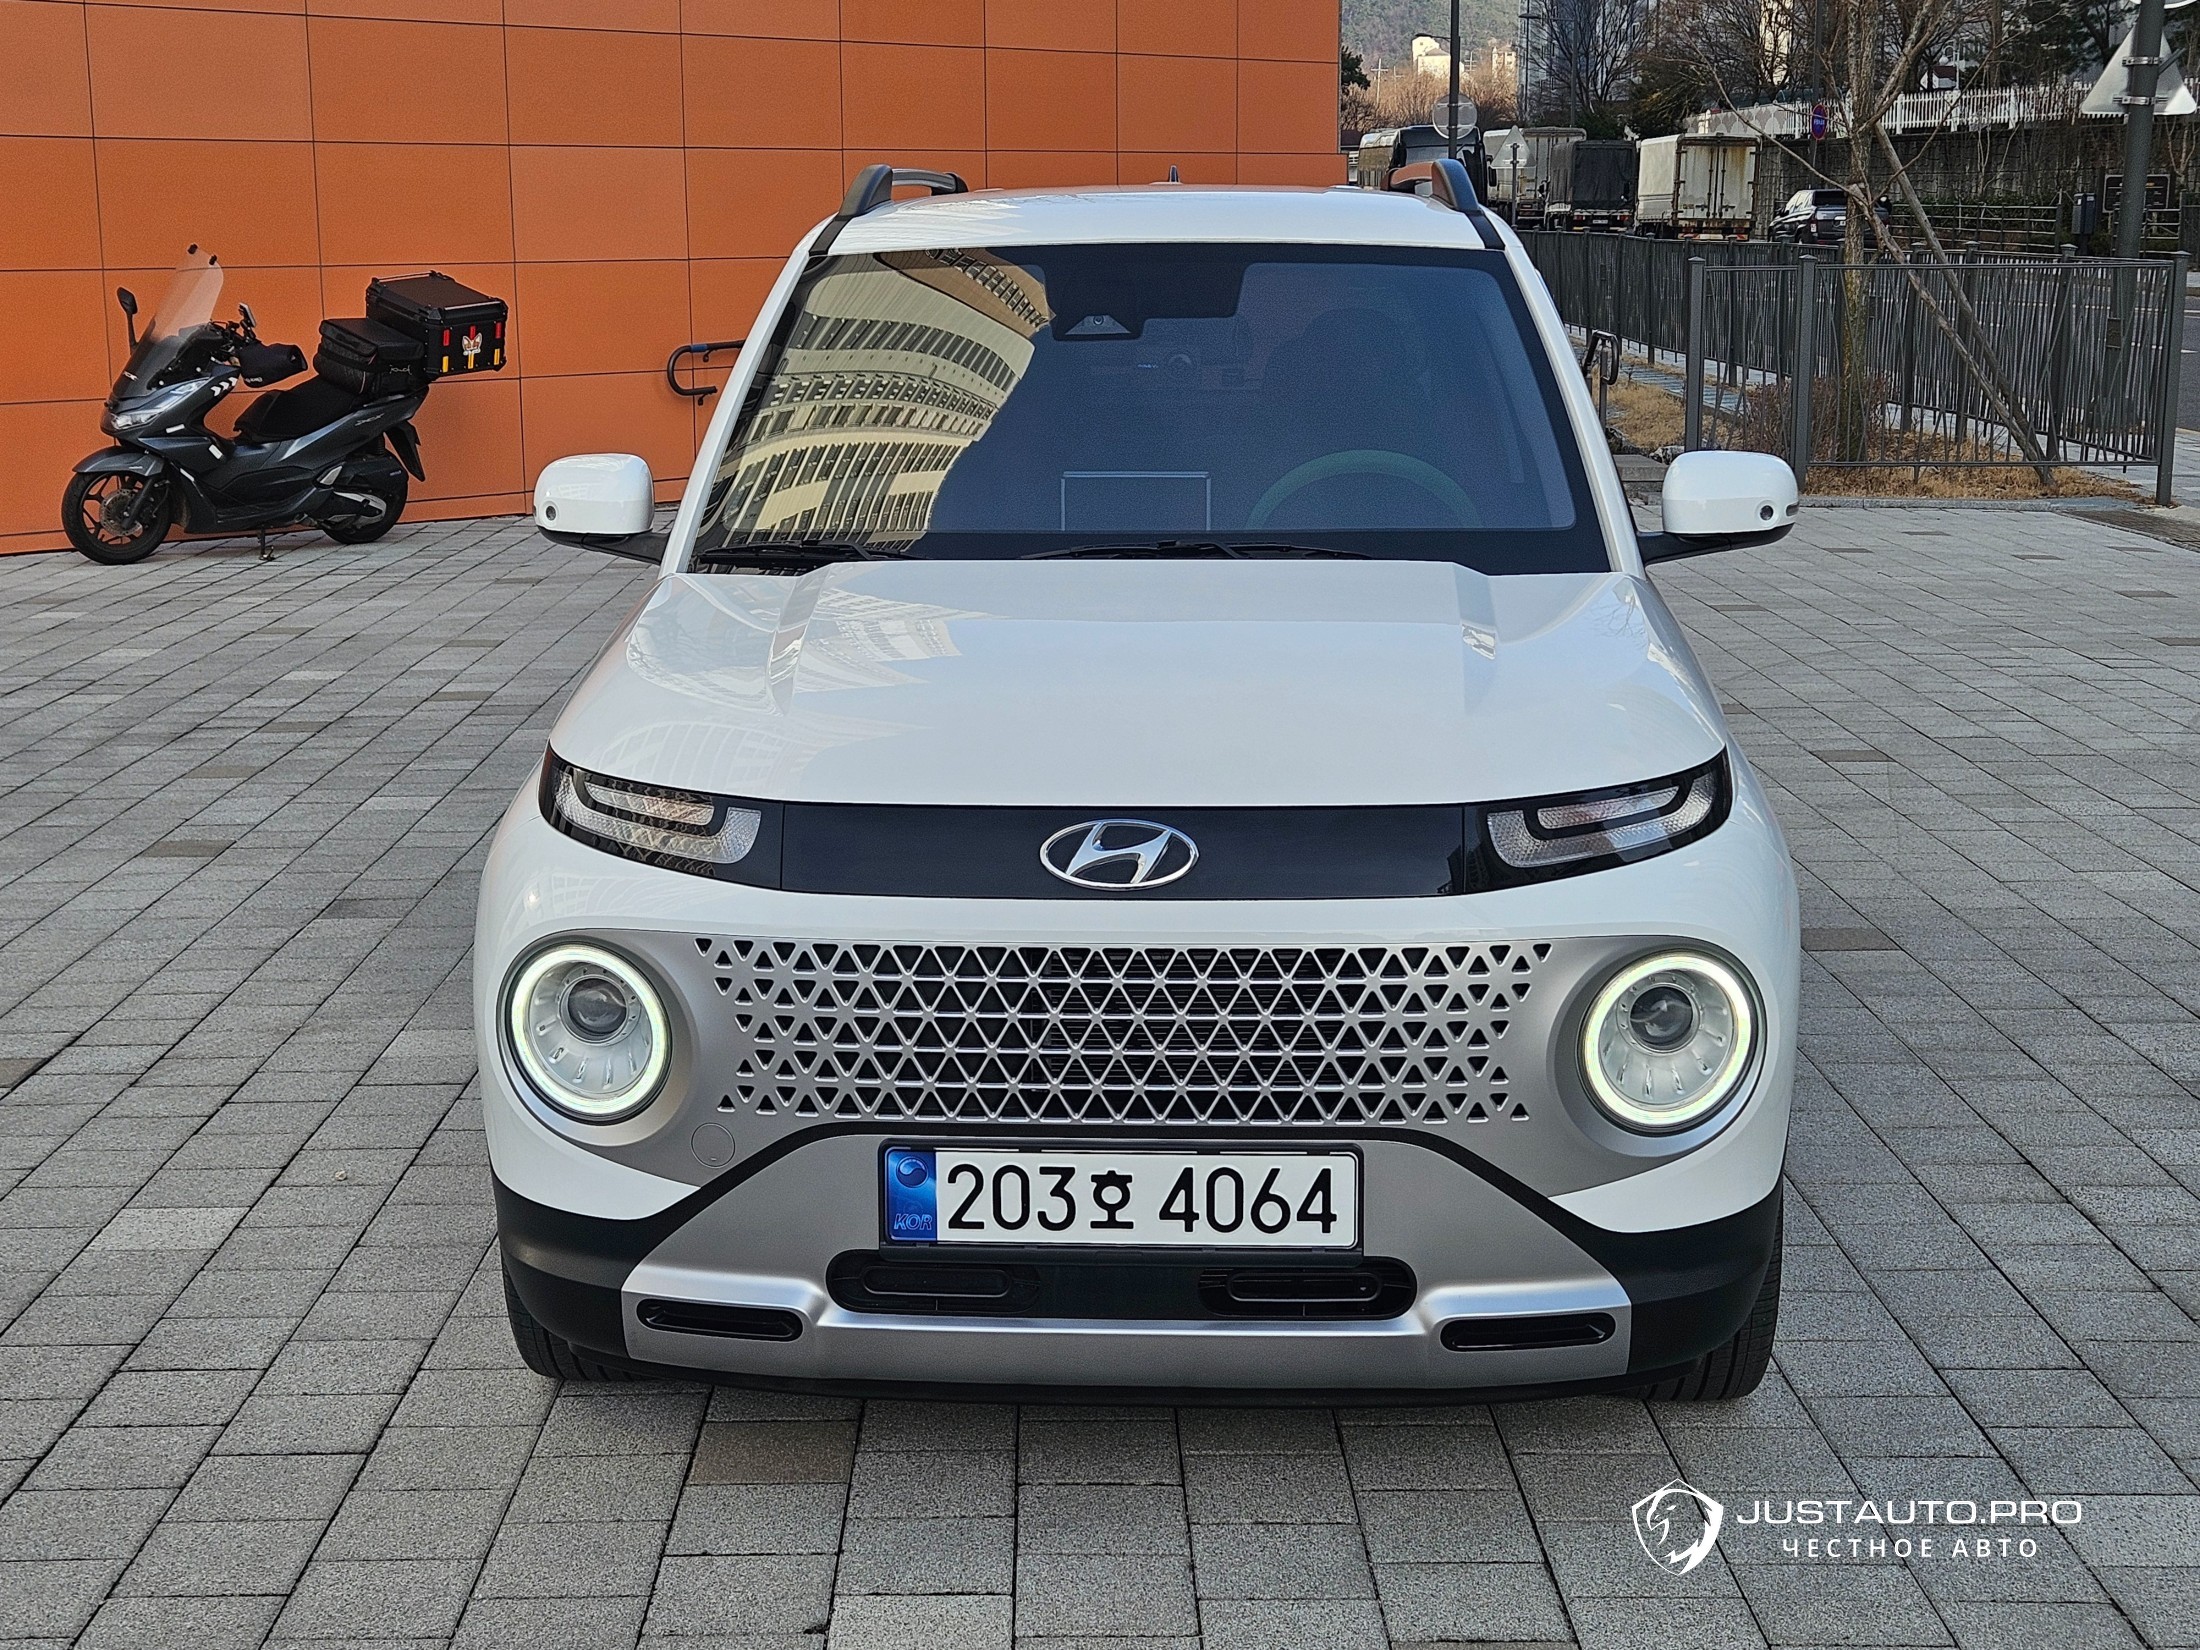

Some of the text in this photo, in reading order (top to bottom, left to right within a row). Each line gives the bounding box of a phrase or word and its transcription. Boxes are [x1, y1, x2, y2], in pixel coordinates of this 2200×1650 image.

[947, 1163, 1338, 1235] 203호 4064
[893, 1213, 933, 1231] KOR
